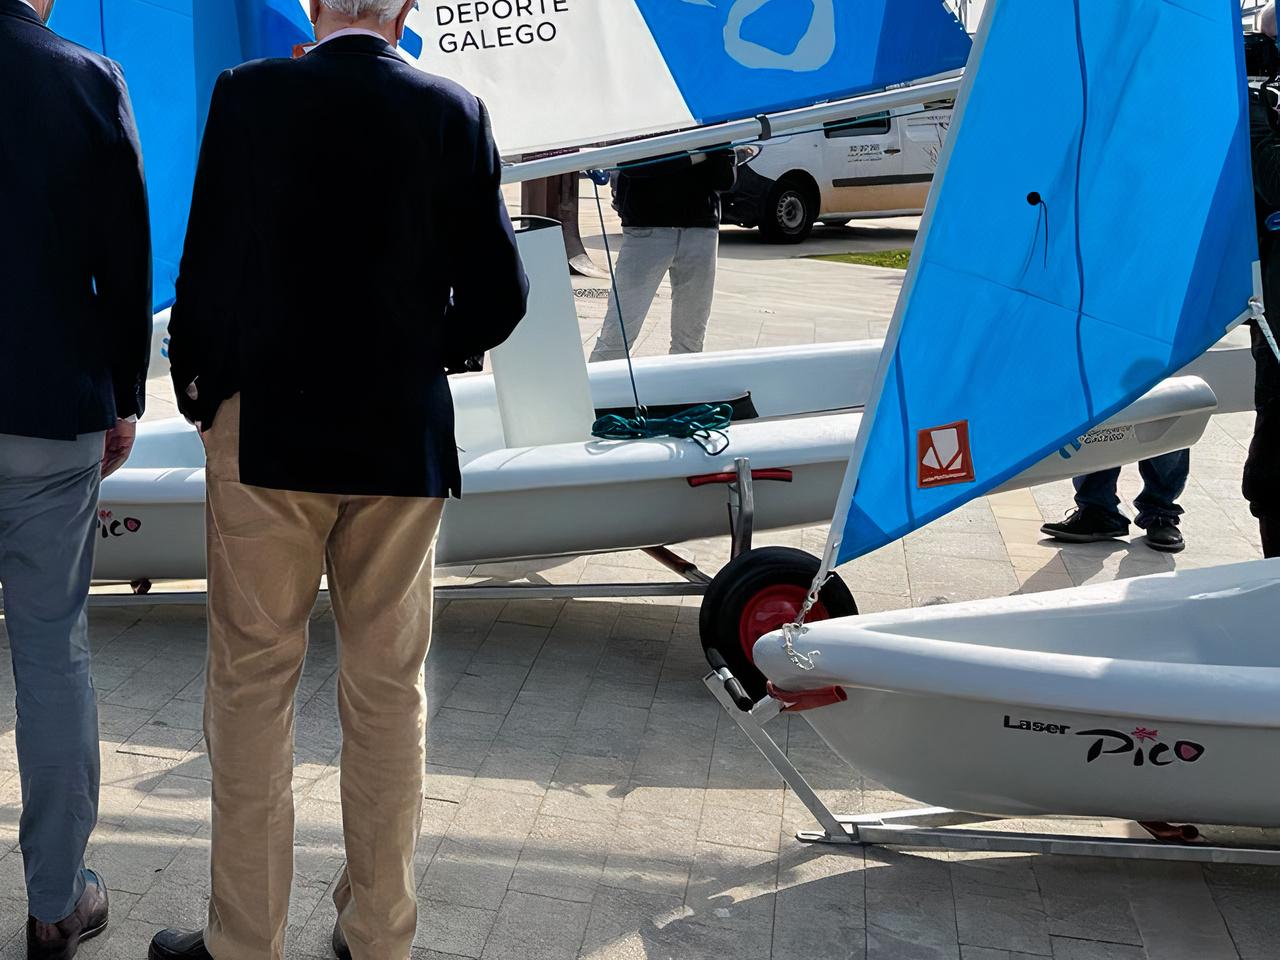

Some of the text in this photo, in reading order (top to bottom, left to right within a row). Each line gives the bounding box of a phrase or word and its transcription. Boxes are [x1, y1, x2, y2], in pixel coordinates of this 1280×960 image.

[438, 21, 557, 53] GALEGO
[98, 509, 141, 538] ico
[1003, 715, 1204, 766] Laser Pico
